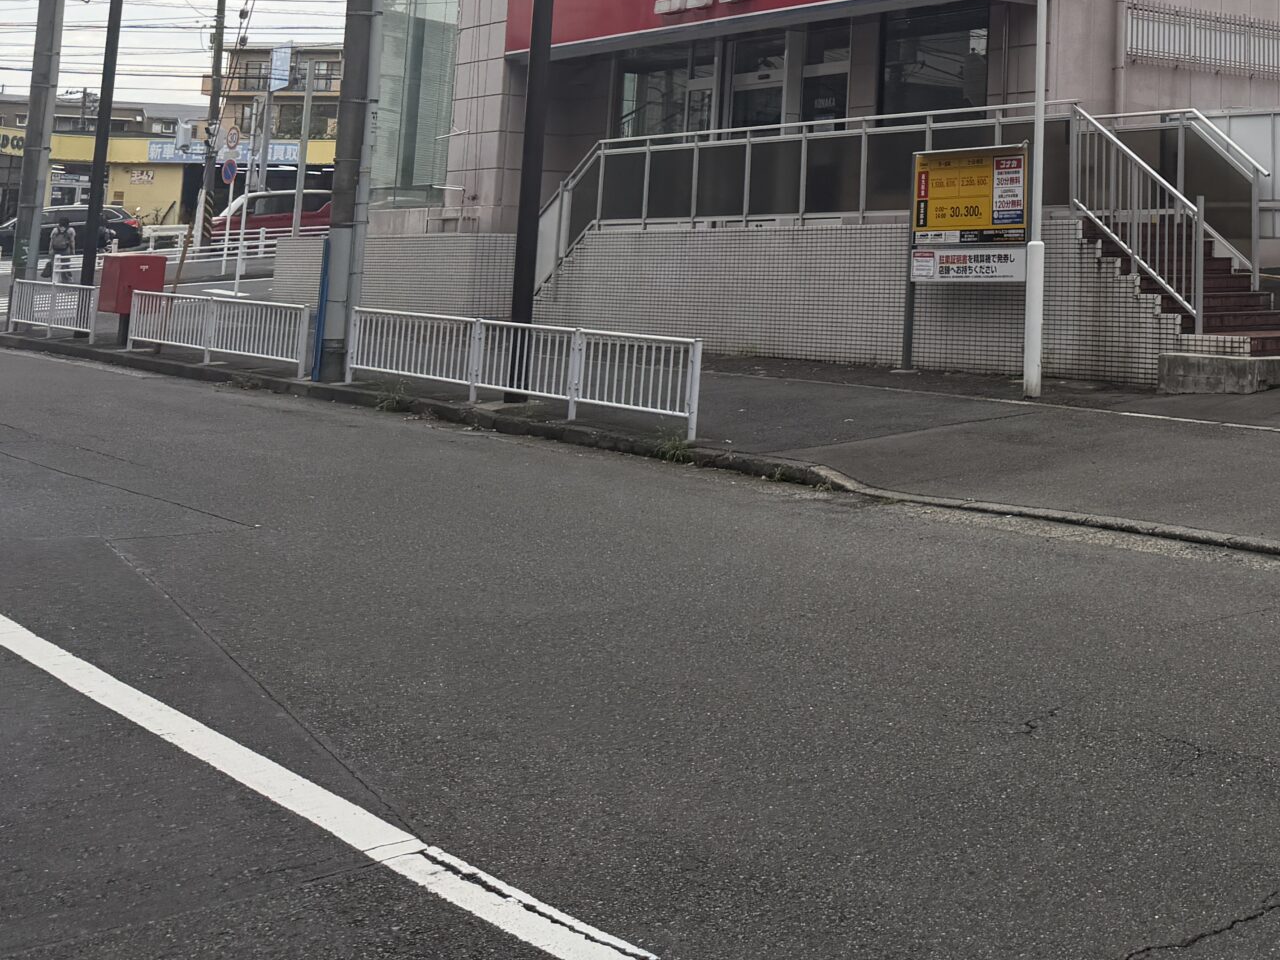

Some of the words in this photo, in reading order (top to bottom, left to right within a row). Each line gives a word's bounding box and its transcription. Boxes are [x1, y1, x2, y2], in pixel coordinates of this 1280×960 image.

[1000, 160, 1017, 168] コナカ
[995, 199, 1022, 210] 120分無料
[938, 265, 997, 275] 店舗へお持ちください
